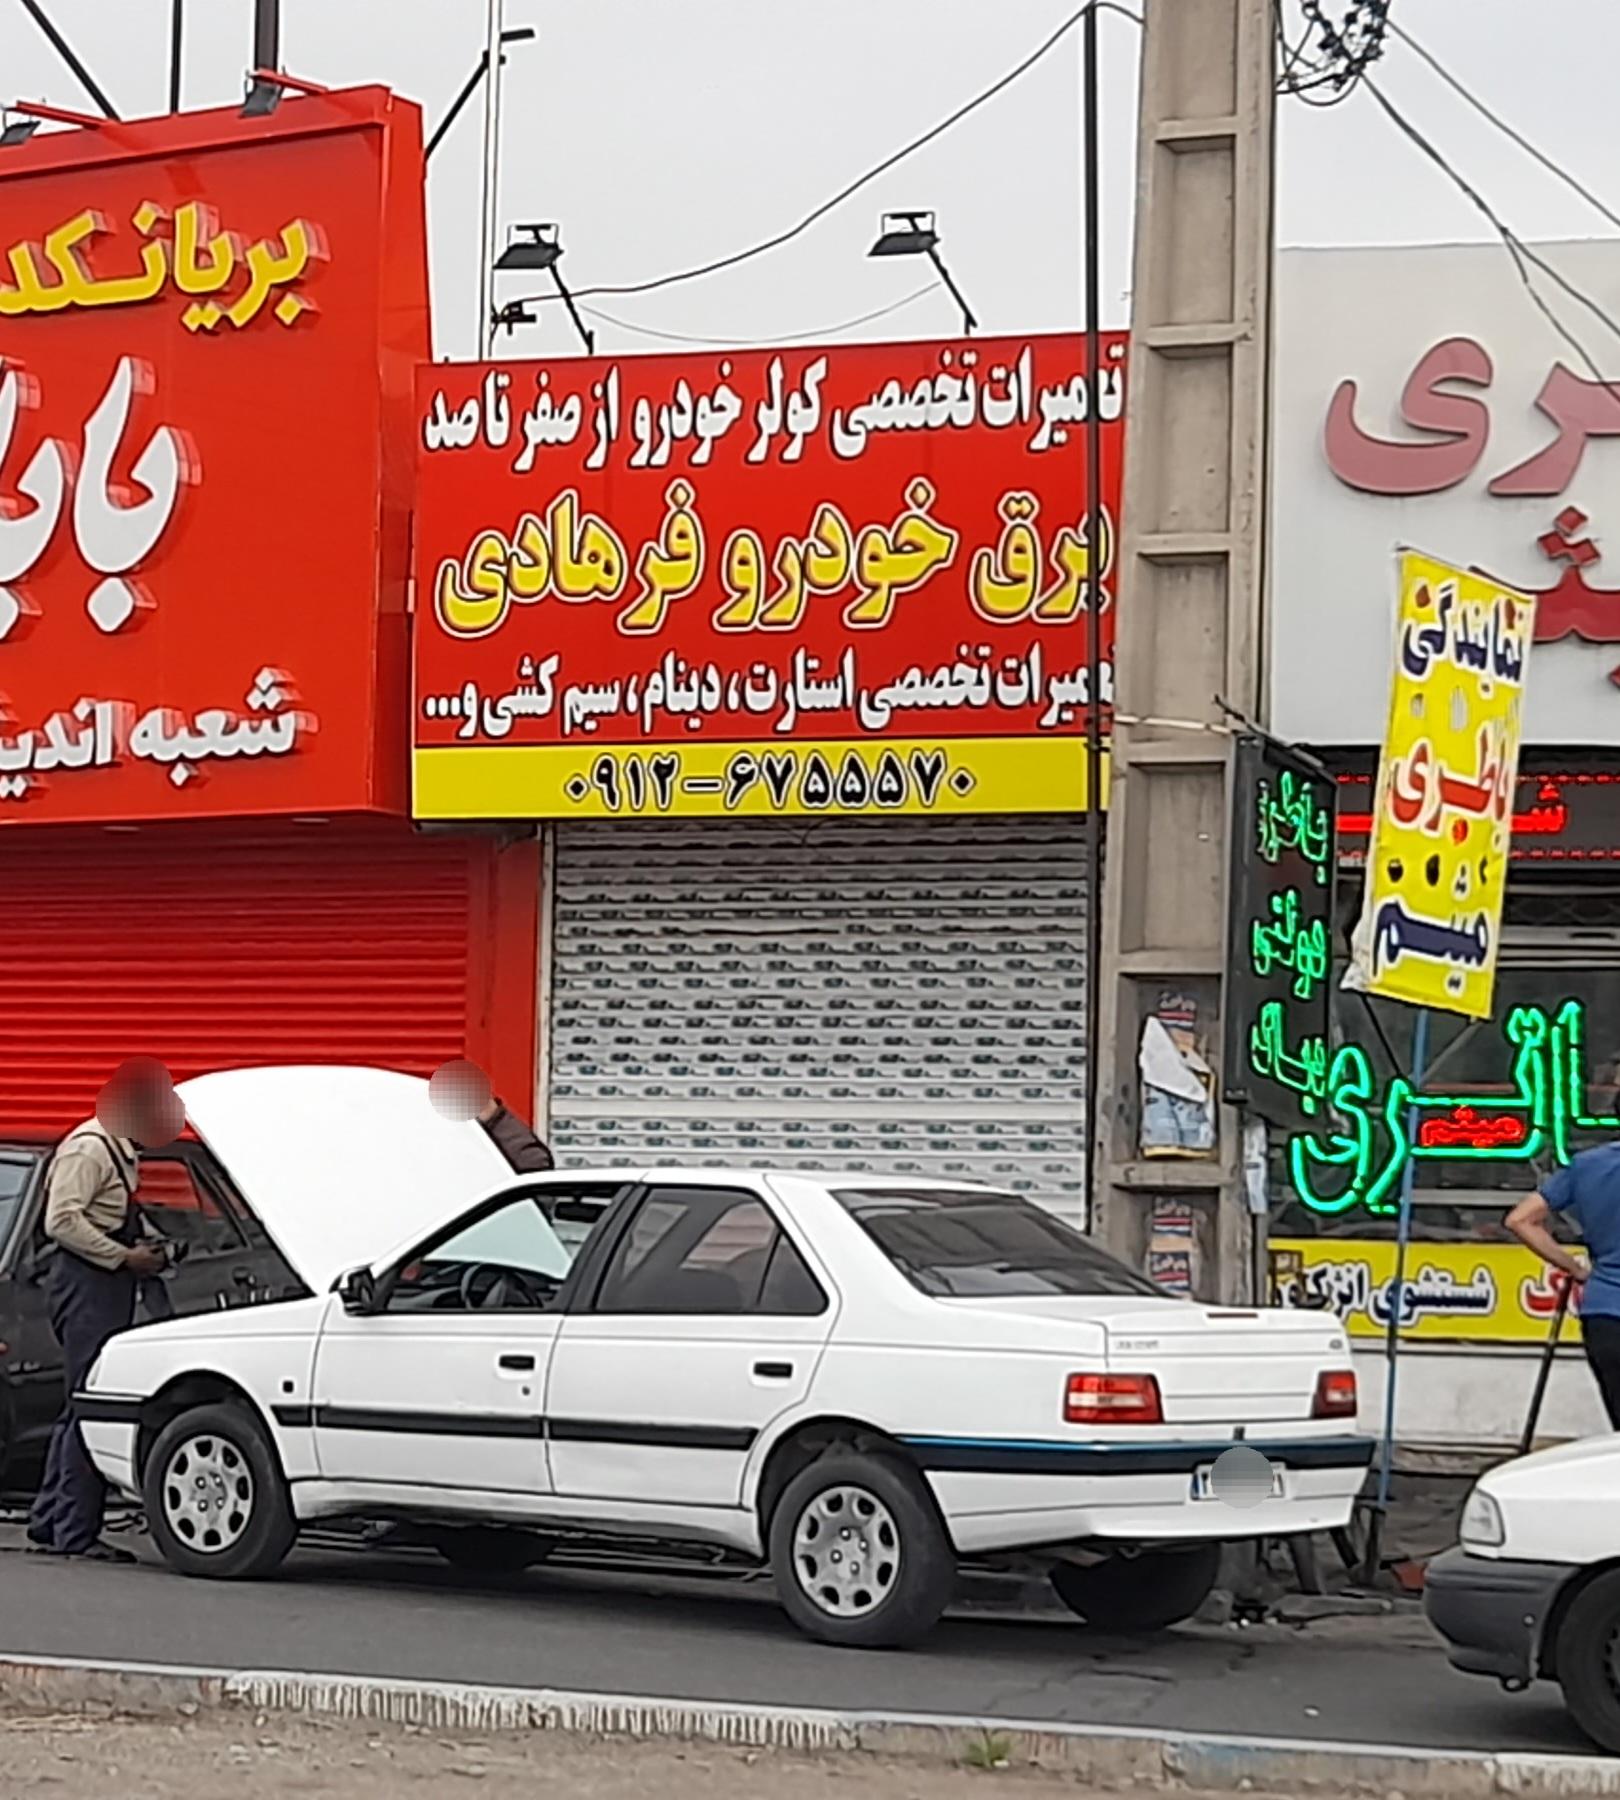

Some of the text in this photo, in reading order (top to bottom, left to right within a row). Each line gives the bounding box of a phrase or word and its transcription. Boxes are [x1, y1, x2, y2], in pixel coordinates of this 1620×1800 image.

[425, 391, 480, 449] صد
[485, 370, 511, 447] تا
[514, 371, 583, 471] صفر
[586, 366, 620, 468] از
[629, 361, 743, 470] خودرو
[748, 356, 828, 463] کولر
[831, 350, 978, 459] تخصصی
[436, 480, 702, 634] فرهادی
[714, 475, 956, 629] خودرو
[0, 668, 295, 798] شعبه اندی
[483, 655, 559, 736] کشی
[564, 675, 620, 736] سیم
[858, 644, 991, 729] تخصصی
[995, 642, 1115, 727] میرات
